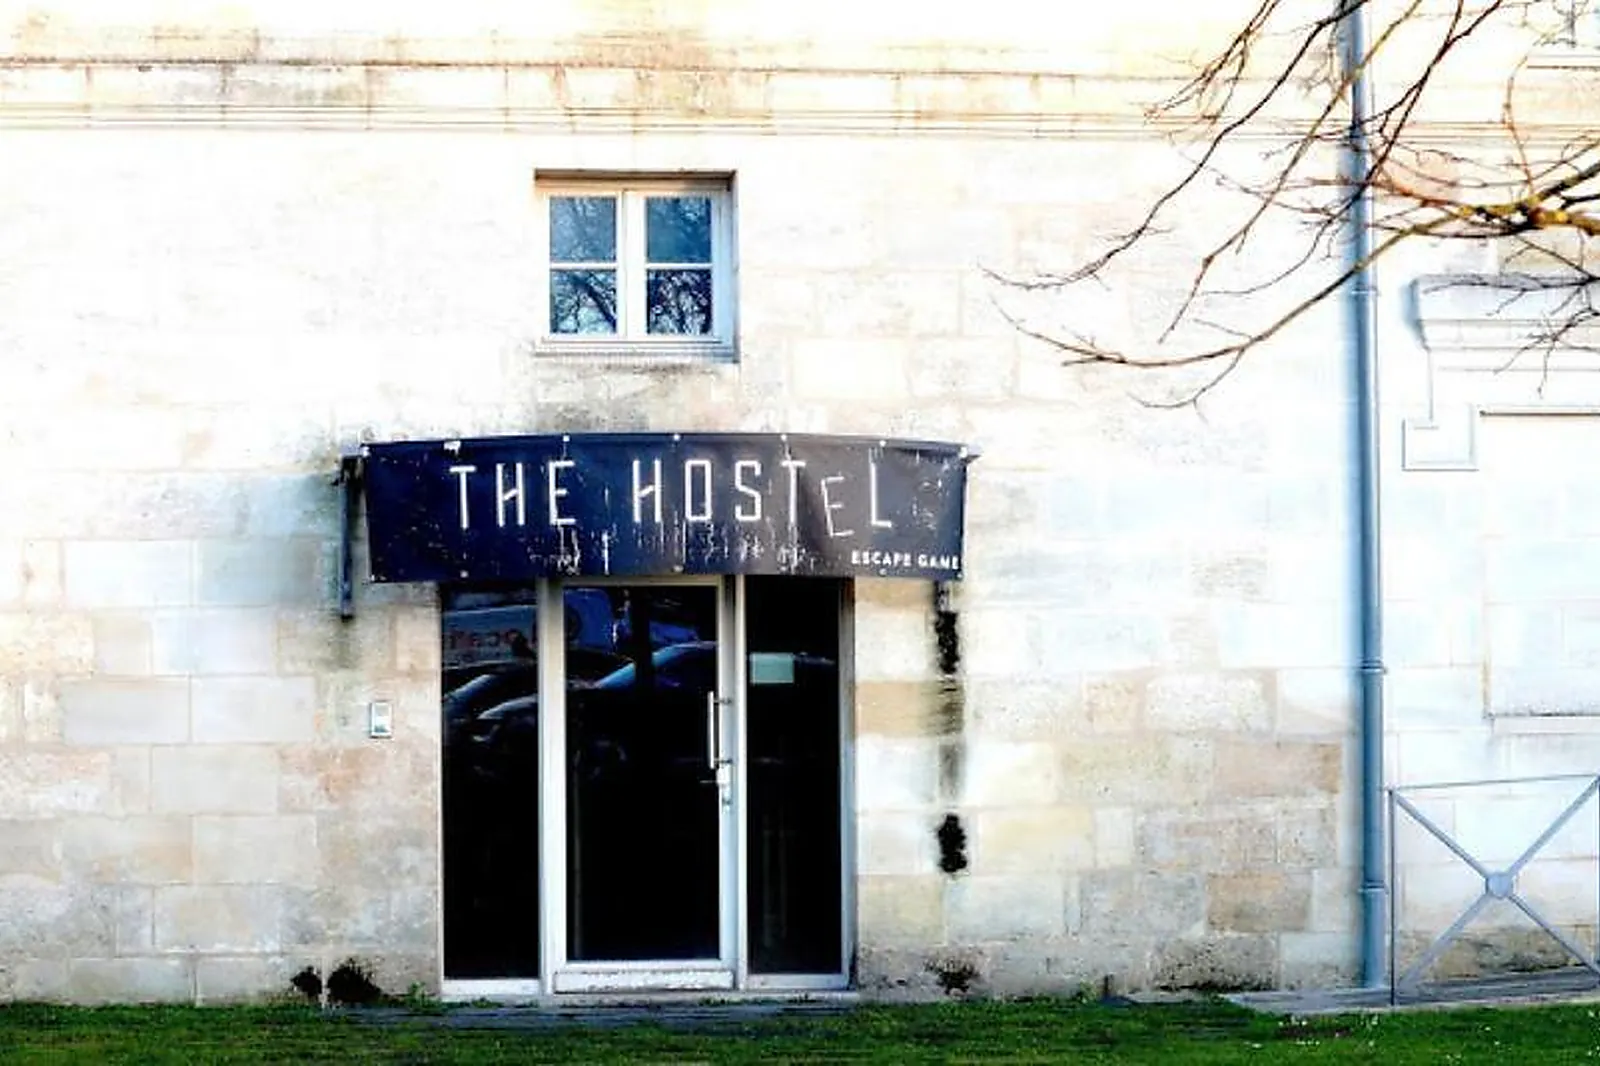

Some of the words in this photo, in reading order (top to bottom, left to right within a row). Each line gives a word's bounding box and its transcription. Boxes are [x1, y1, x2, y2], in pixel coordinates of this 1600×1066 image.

[449, 460, 576, 529] THE
[632, 457, 893, 537] HOSTEL
[851, 550, 912, 567] ESCAPE
[918, 554, 960, 570] GAME
